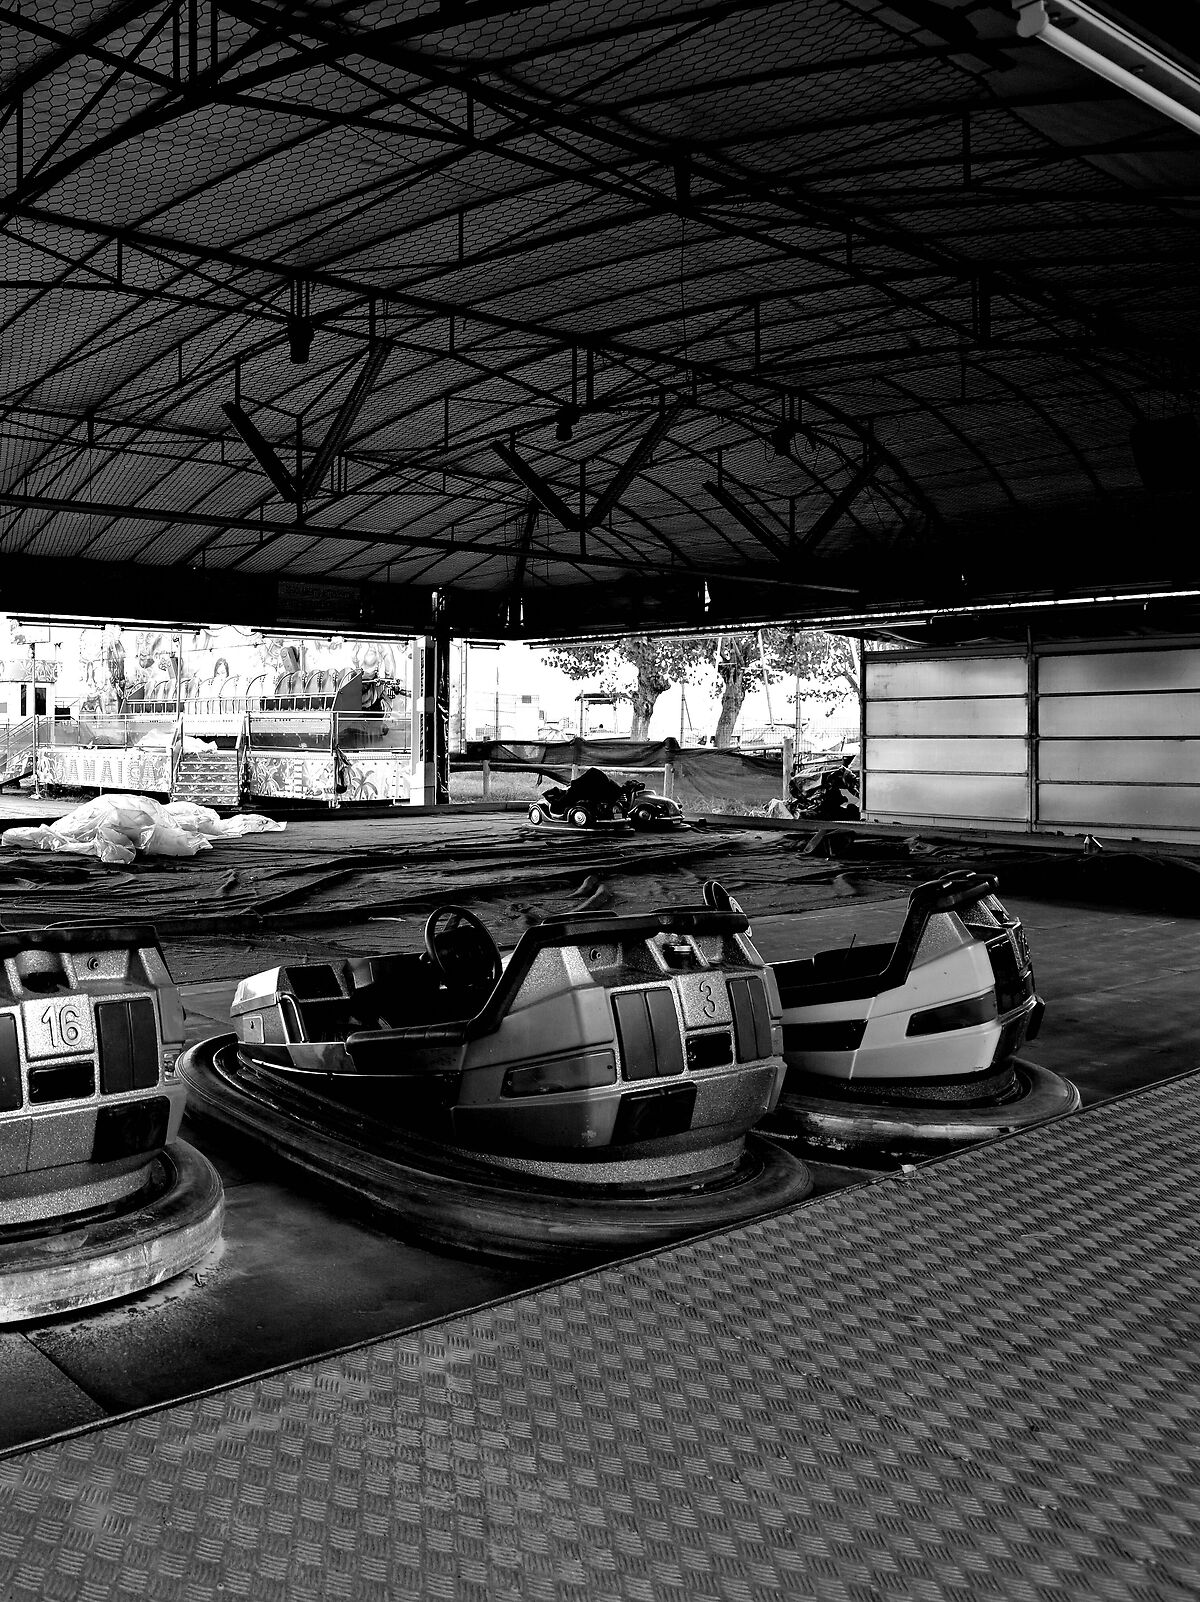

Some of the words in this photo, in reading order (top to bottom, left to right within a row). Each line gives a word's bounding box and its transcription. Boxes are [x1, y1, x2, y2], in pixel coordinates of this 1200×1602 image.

[56, 758, 156, 789] JAMAICA
[699, 980, 717, 1019] 3
[41, 1004, 82, 1048] 16
